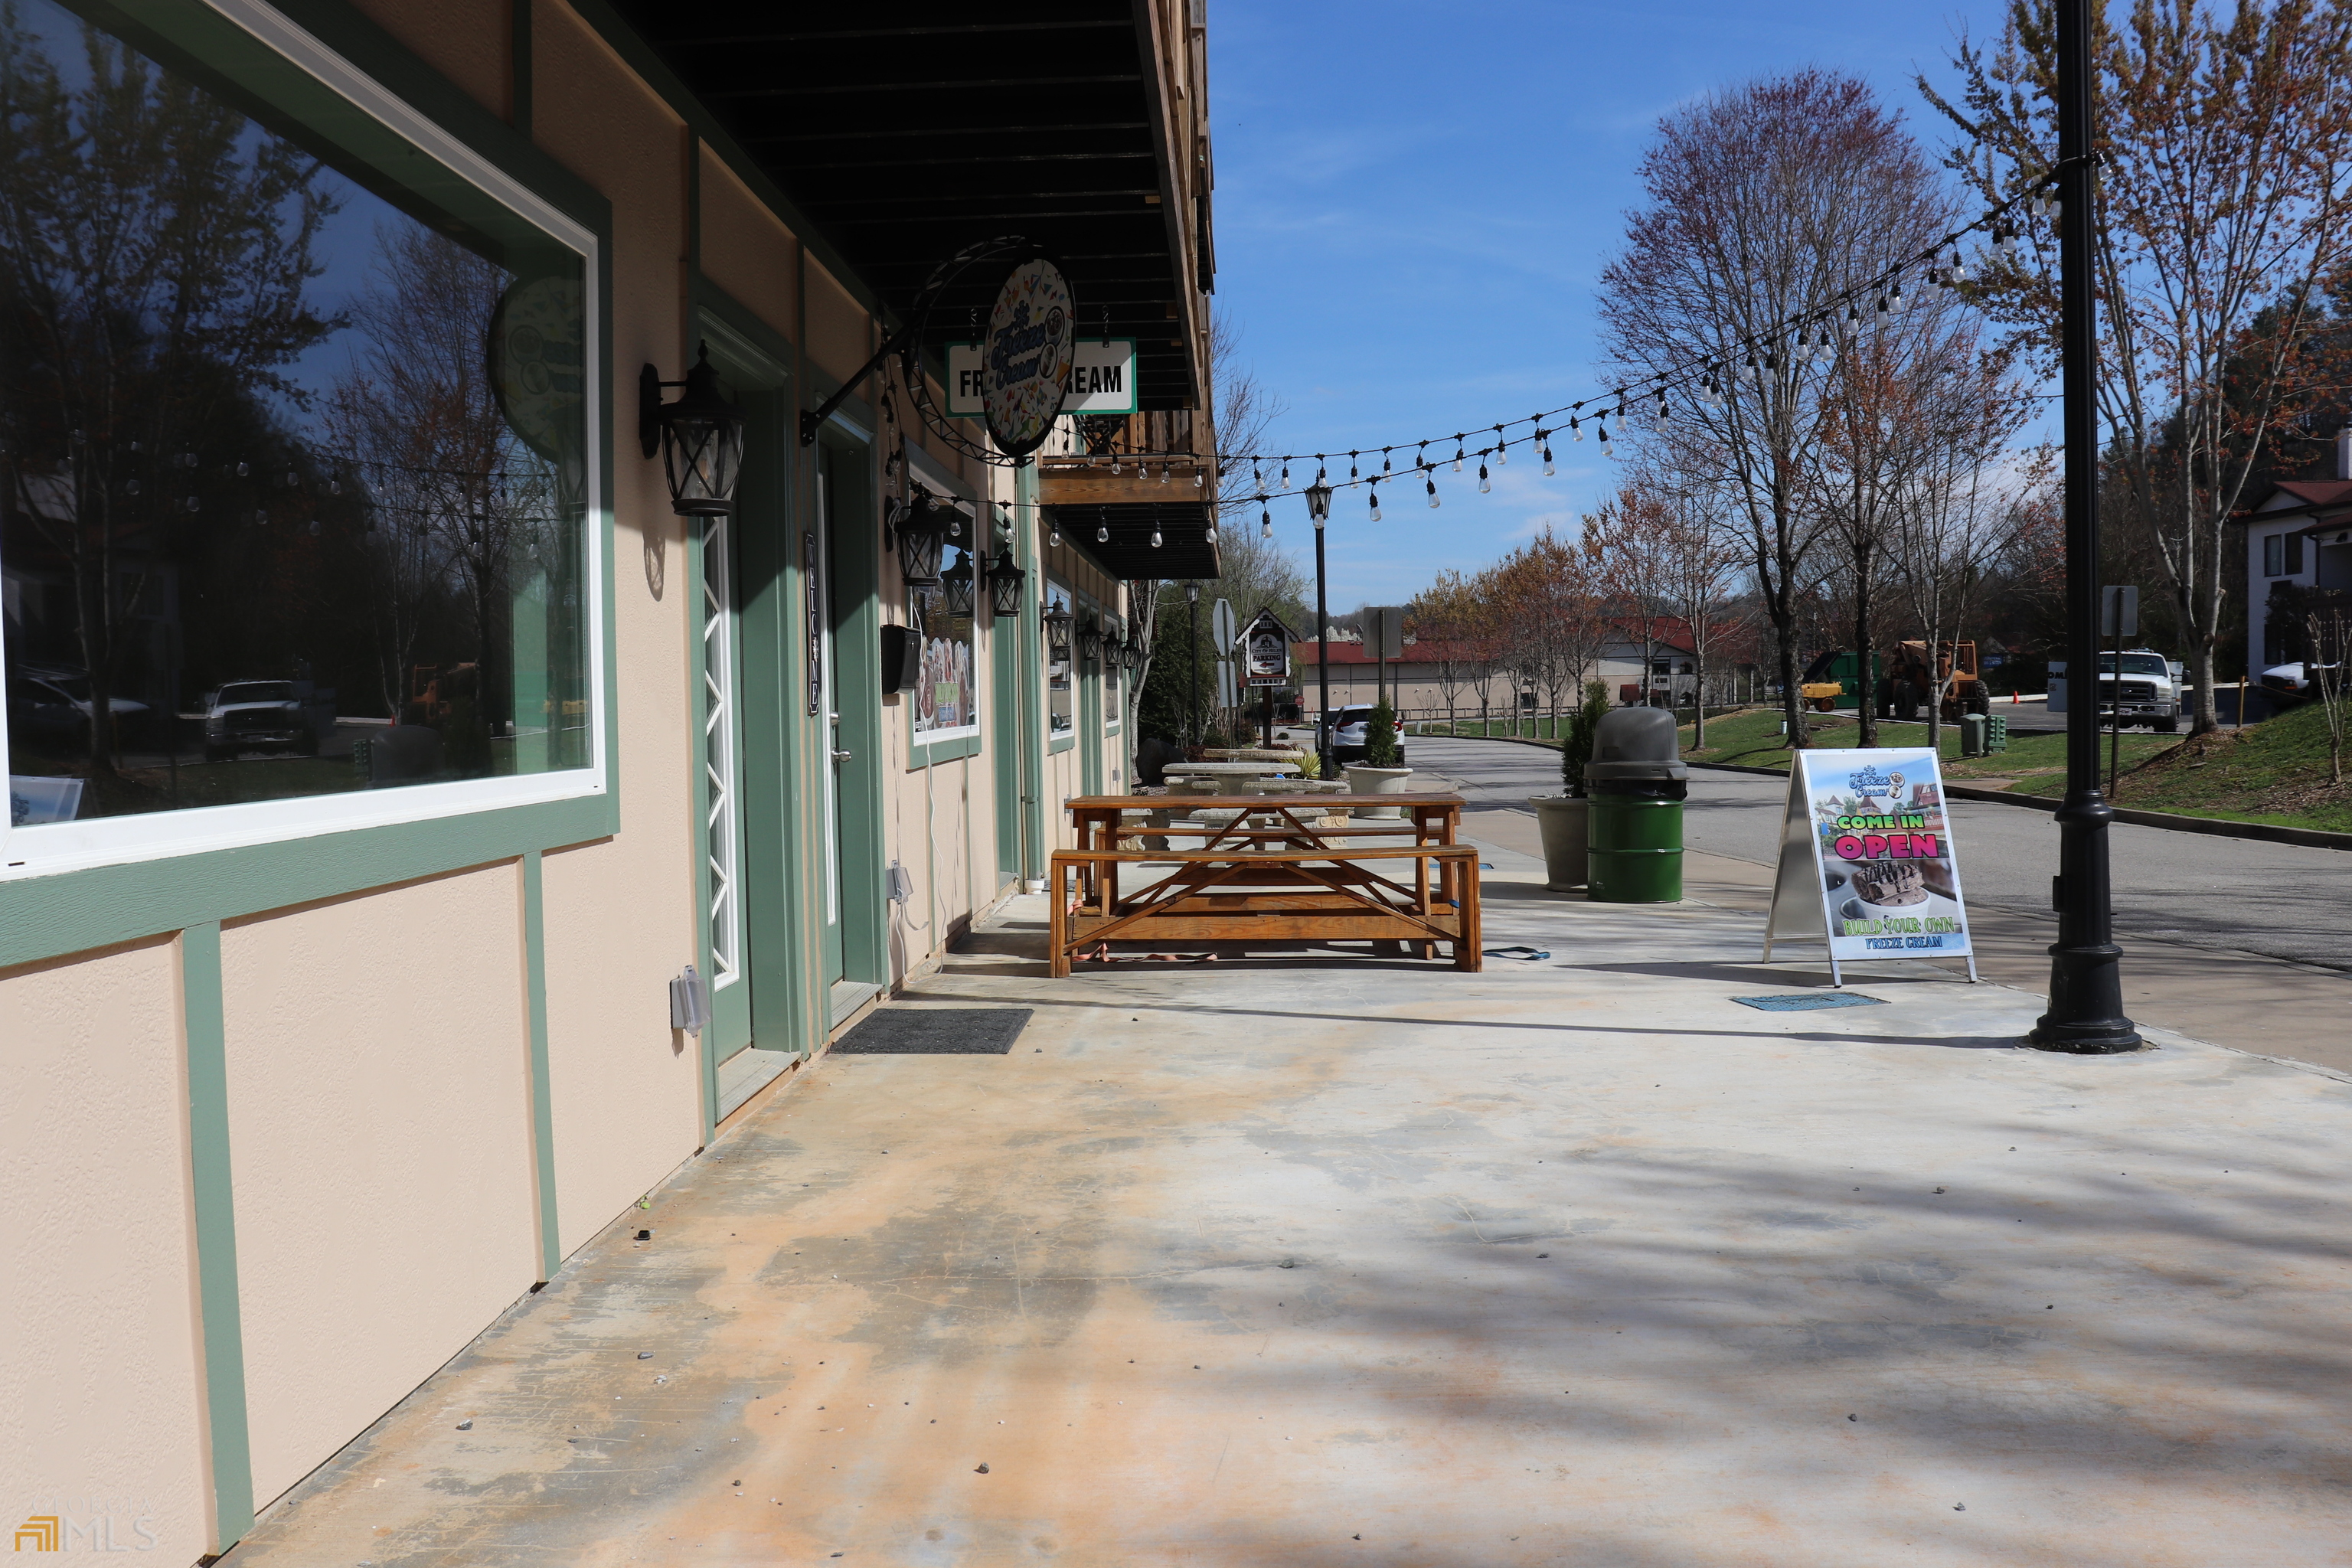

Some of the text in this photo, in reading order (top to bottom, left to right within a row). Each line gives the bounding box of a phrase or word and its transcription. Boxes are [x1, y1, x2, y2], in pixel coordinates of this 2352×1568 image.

[991, 322, 1046, 370] Freeze
[996, 354, 1039, 390] Cream
[1068, 367, 1122, 394] EAM
[808, 544, 818, 704] WELCME
[1849, 772, 1890, 789] Freeze
[1855, 784, 1887, 798] Cream
[1838, 815, 1925, 830] COME IN
[1834, 834, 1939, 860] OPEN
[1842, 916, 1955, 936] BUILD YOUR OWN
[1865, 936, 1943, 949] FREEZE CREAM
